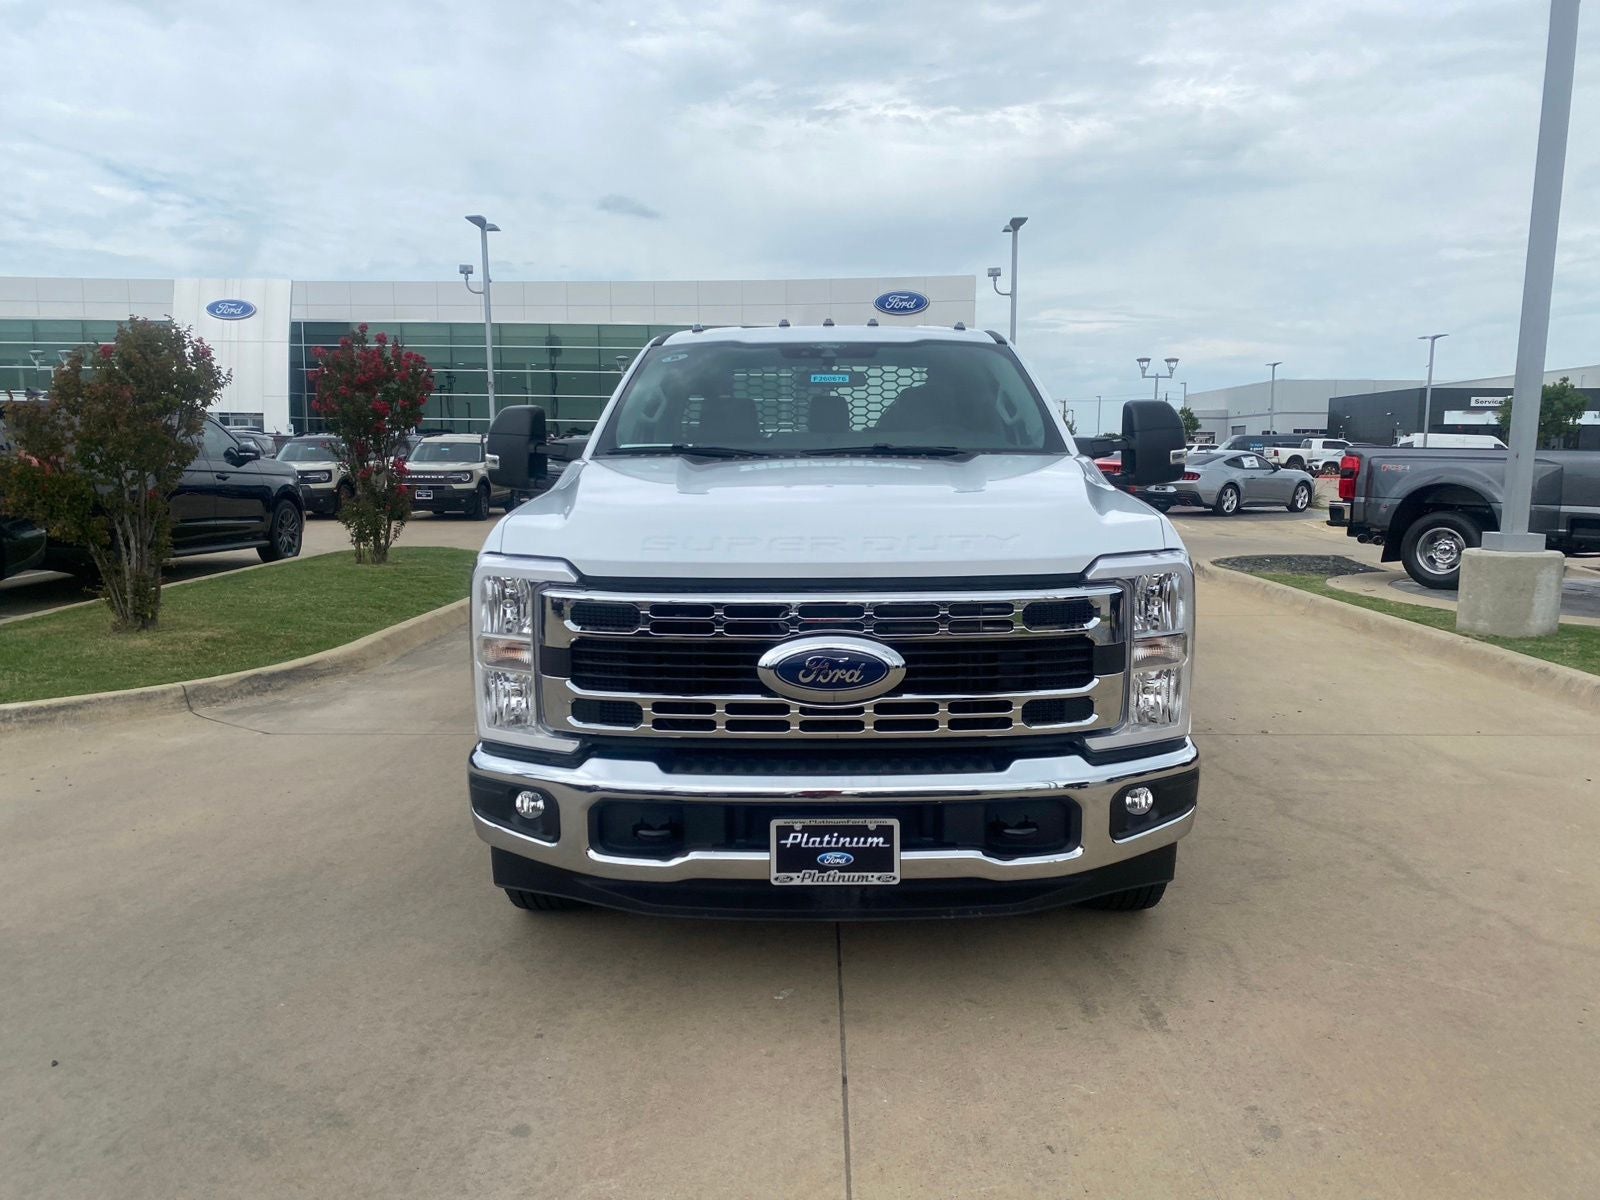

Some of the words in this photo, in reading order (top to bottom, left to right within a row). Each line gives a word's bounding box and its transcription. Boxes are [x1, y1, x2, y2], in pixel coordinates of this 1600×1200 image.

[215, 302, 244, 314] Ford
[885, 295, 917, 309] Ford
[641, 535, 847, 552] SUPER
[862, 533, 1022, 552] DUTY
[798, 655, 865, 684] Ford
[779, 832, 891, 848] Platinum
[824, 854, 847, 864] Ford
[800, 870, 874, 883] Platinum
